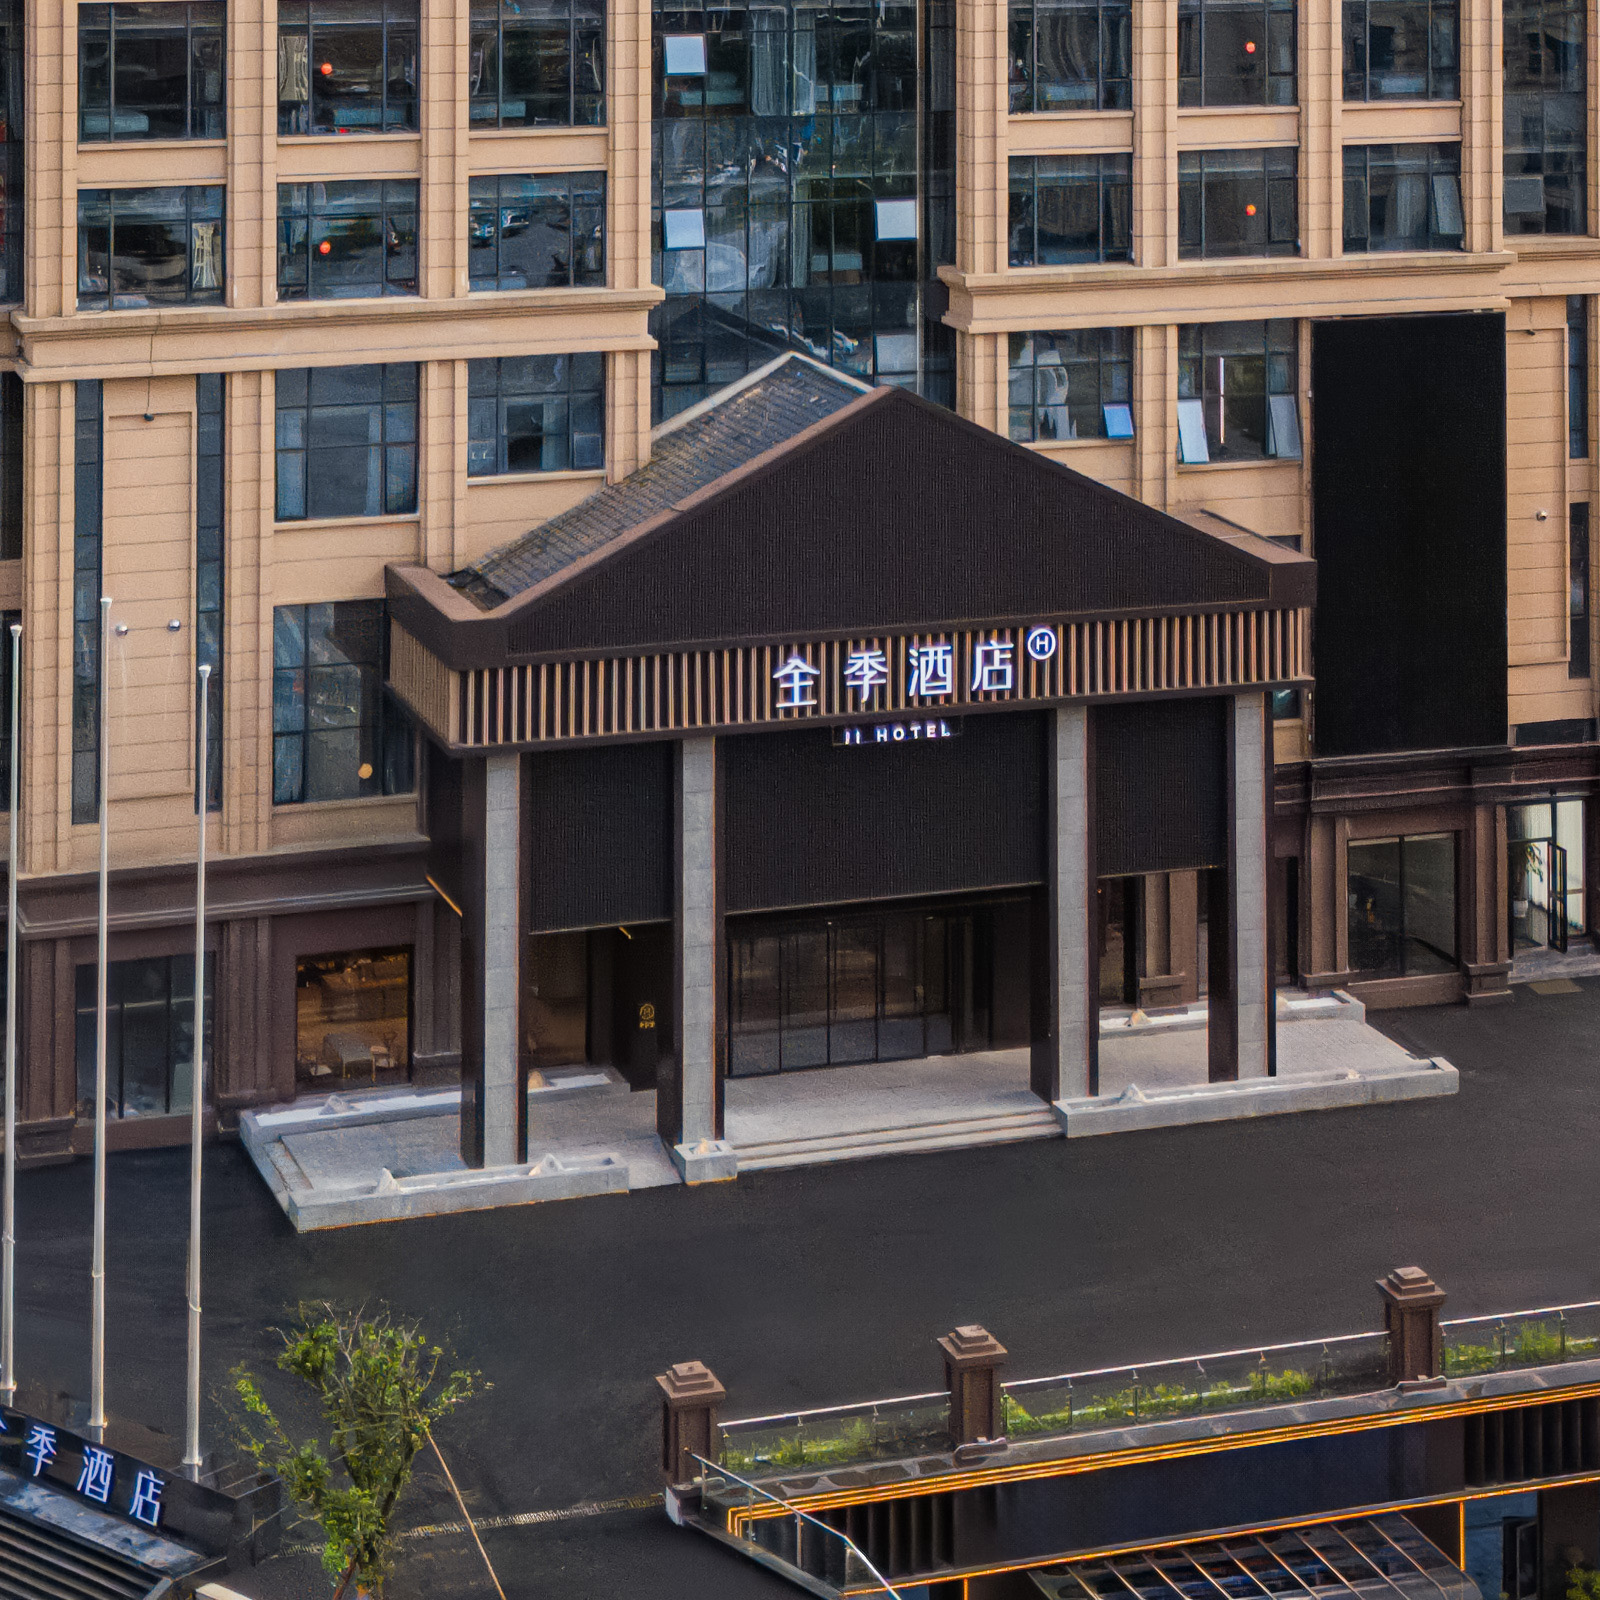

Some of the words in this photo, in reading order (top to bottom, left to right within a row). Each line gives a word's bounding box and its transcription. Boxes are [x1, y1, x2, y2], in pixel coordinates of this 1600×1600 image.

[773, 640, 1014, 709] 全季酒店
[876, 720, 951, 742] HOTEL
